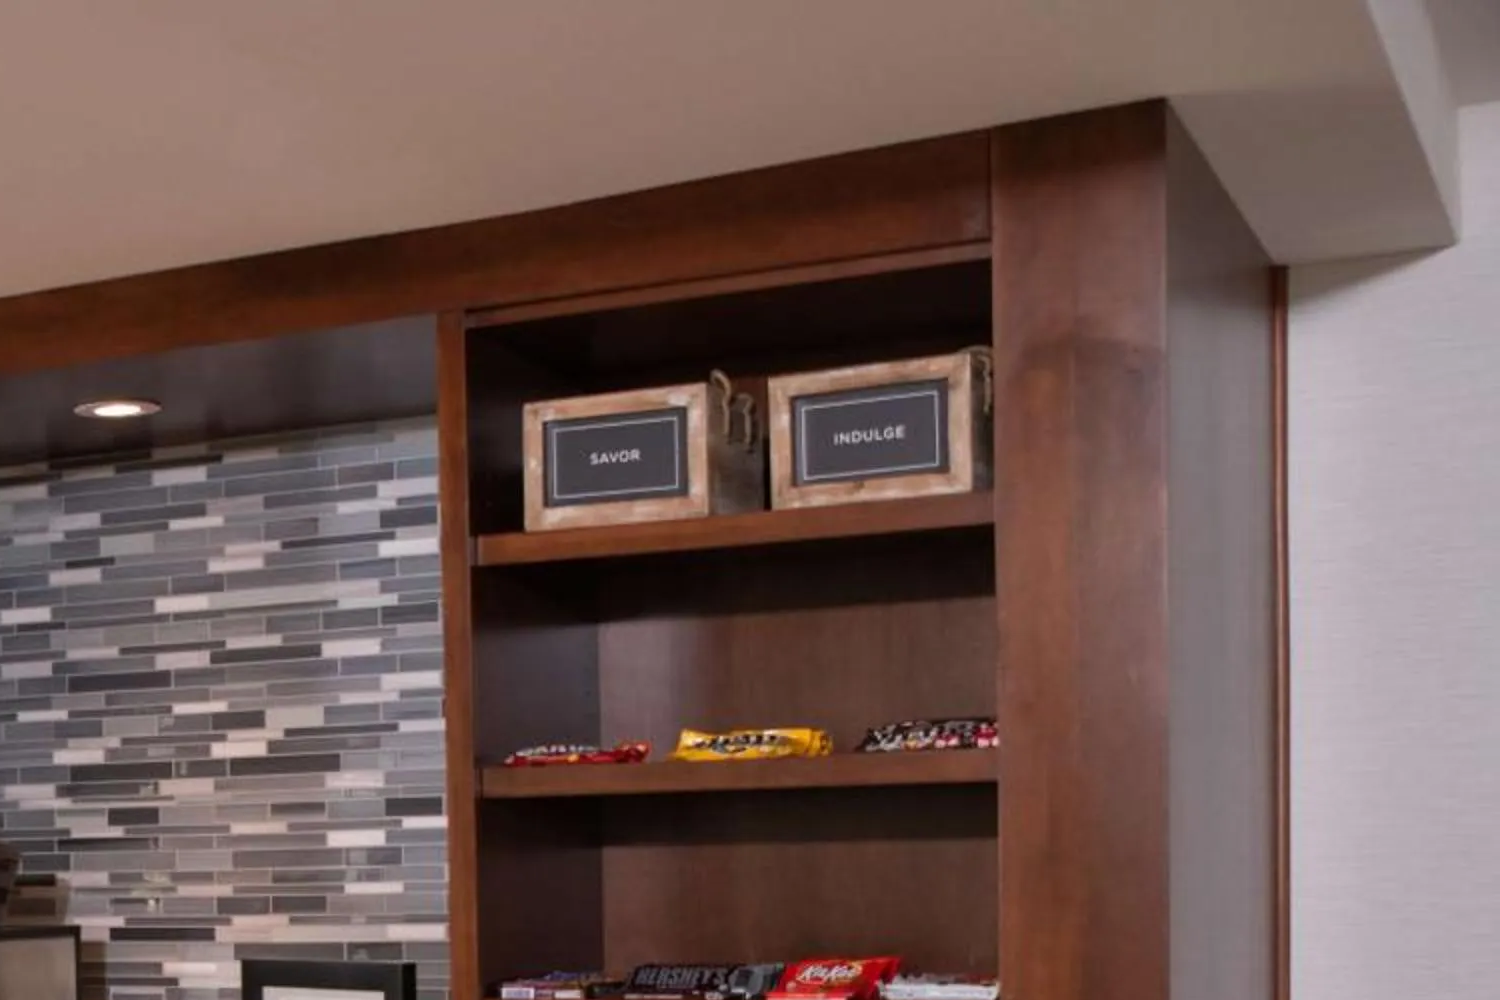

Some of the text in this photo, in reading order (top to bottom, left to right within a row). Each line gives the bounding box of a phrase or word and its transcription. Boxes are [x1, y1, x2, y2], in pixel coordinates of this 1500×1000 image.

[833, 425, 906, 446] INDULGE
[590, 449, 642, 465] SAVOR
[634, 966, 726, 985] HERSHEY'S
